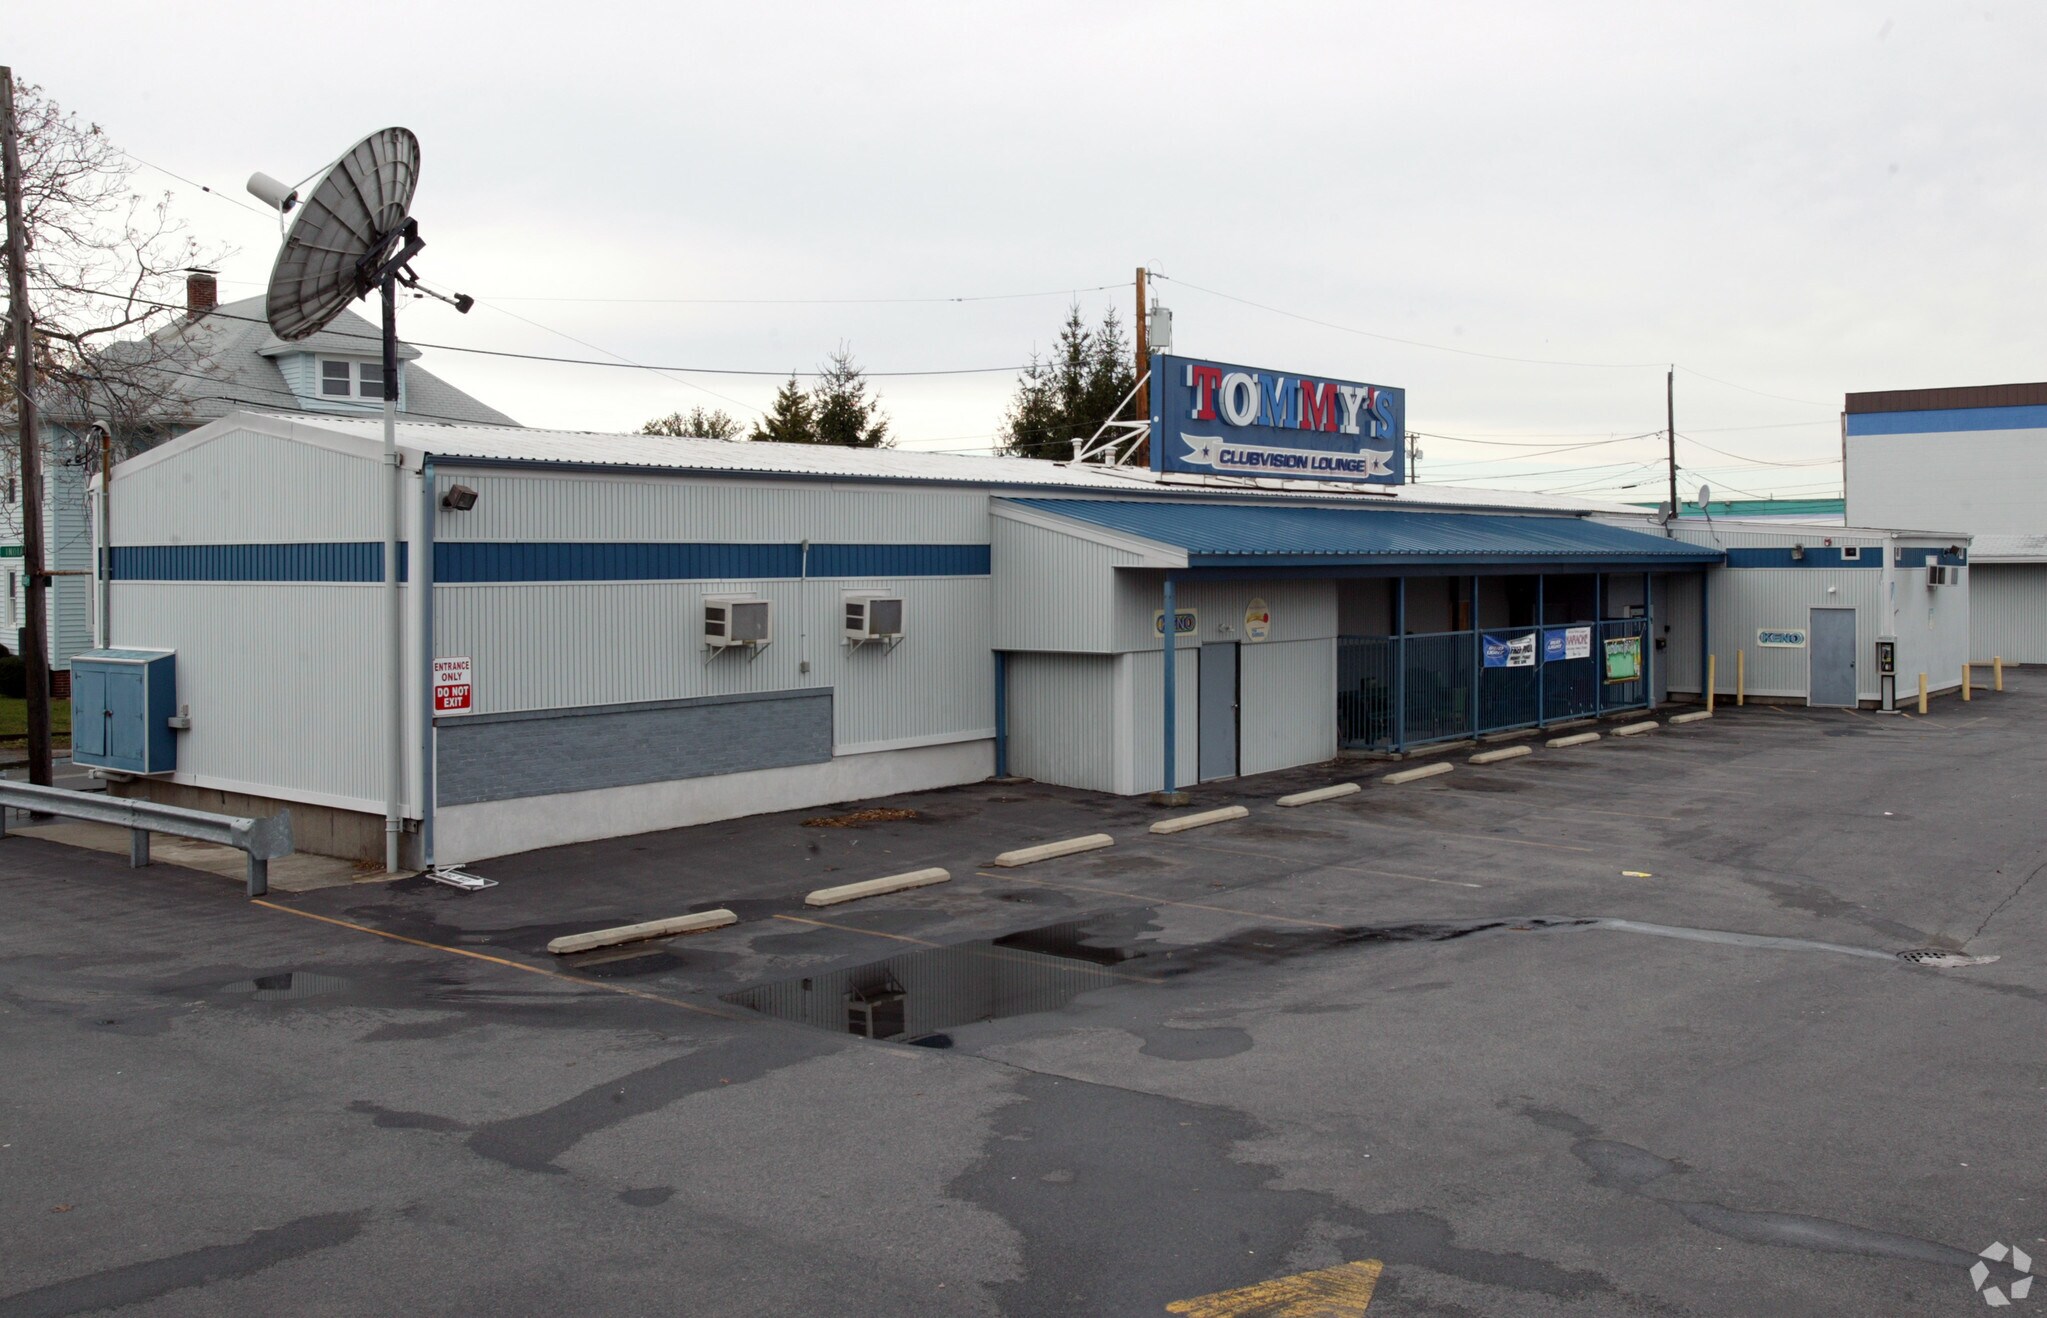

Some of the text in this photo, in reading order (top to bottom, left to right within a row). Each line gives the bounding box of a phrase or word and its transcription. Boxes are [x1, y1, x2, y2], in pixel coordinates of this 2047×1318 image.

[1187, 364, 1395, 439] TOMMY'S
[1219, 449, 1366, 473] CLUBVISION LOUNGE
[1763, 631, 1800, 644] KENO
[434, 661, 470, 672] ENTRANCE
[441, 672, 463, 682] ONLY
[437, 685, 469, 698] DO NOT
[443, 697, 463, 708] EXIT
